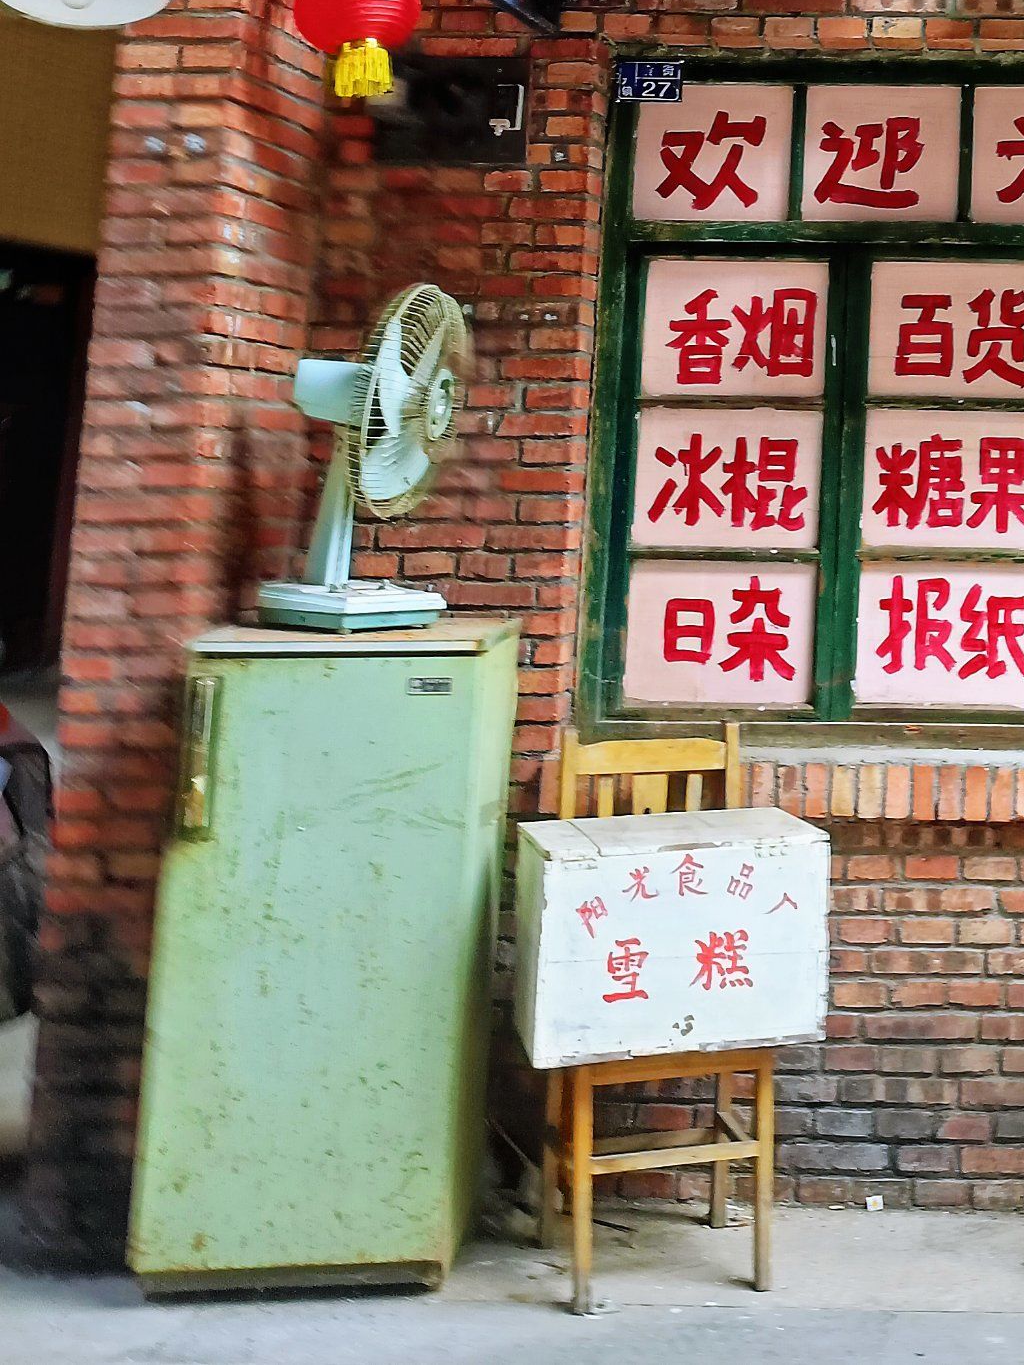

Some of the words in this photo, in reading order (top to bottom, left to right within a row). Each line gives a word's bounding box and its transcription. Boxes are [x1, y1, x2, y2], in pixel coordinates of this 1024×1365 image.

[641, 81, 672, 98] 27
[667, 287, 818, 386] 香烟
[646, 433, 808, 531] 冰棍
[663, 574, 797, 683] 日杂
[602, 929, 754, 1004] 雪糕
